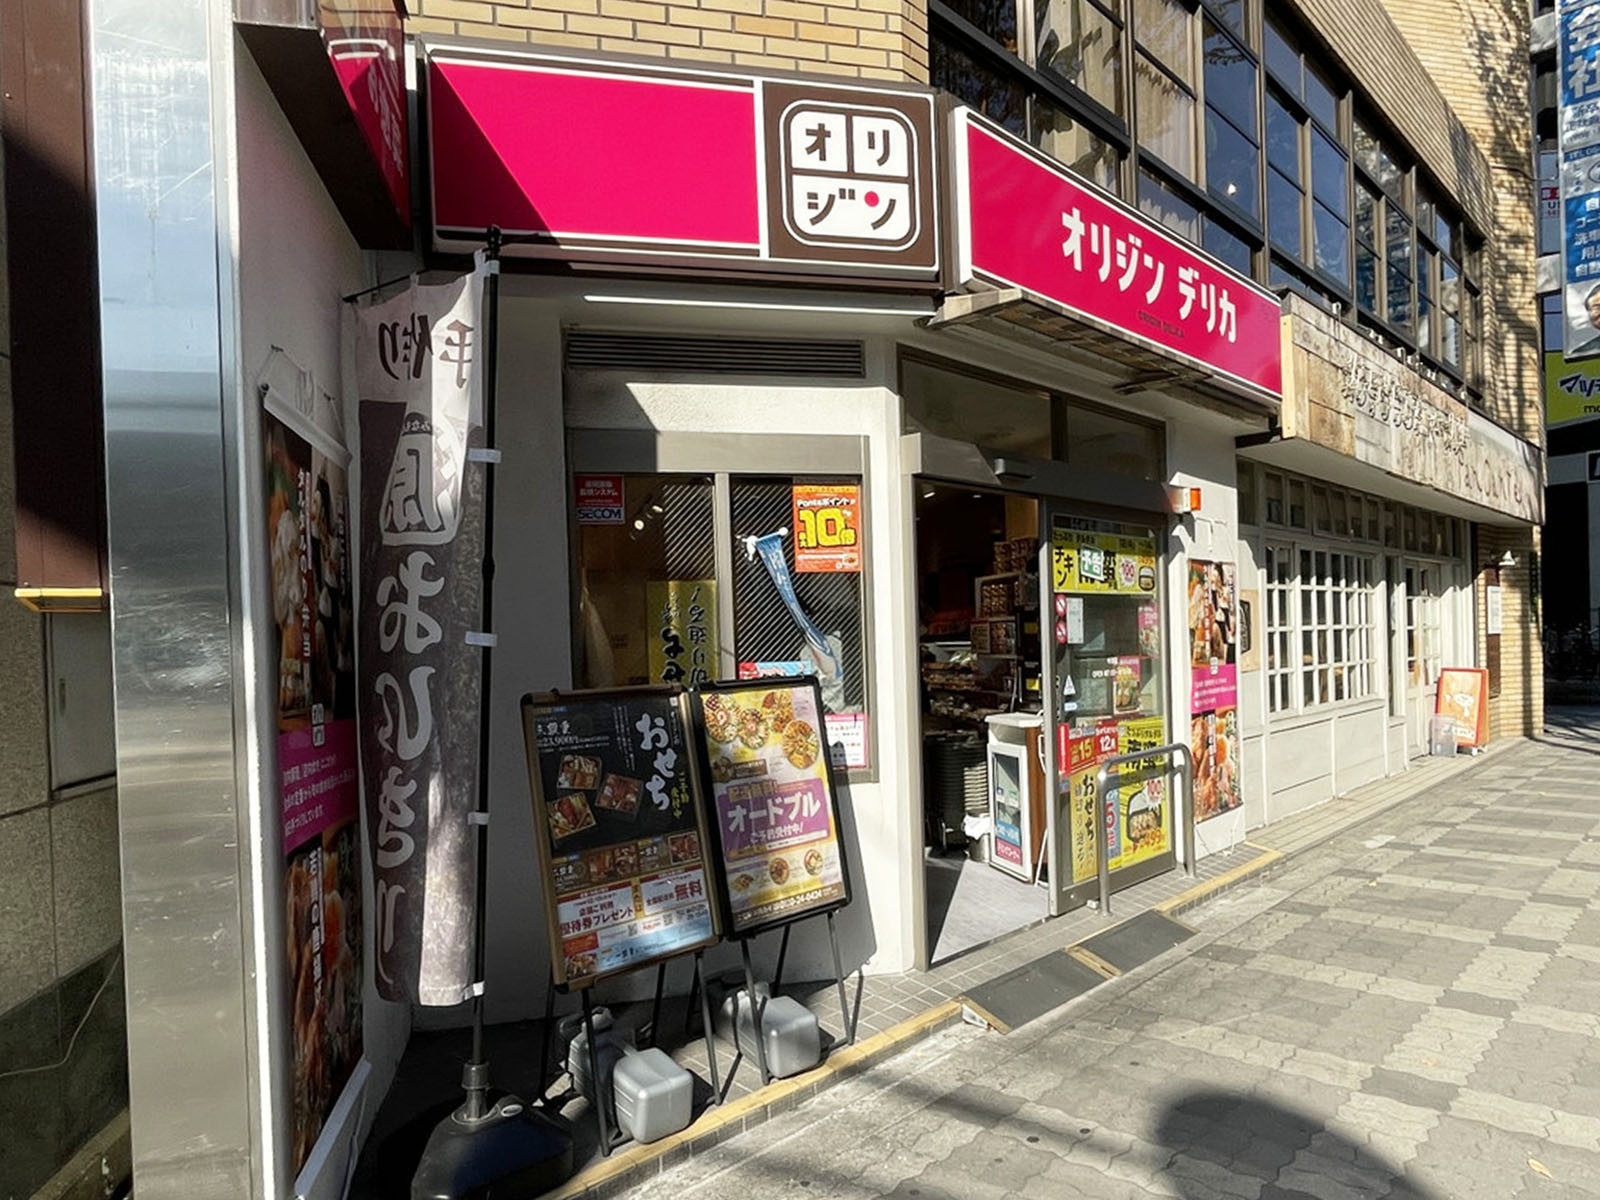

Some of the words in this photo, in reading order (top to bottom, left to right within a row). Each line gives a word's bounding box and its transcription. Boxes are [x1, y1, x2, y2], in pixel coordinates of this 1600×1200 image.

[1060, 207, 1165, 304] オリジン
[1177, 262, 1238, 343] デリカ
[635, 713, 677, 811] おせち
[727, 791, 821, 833] オードブル
